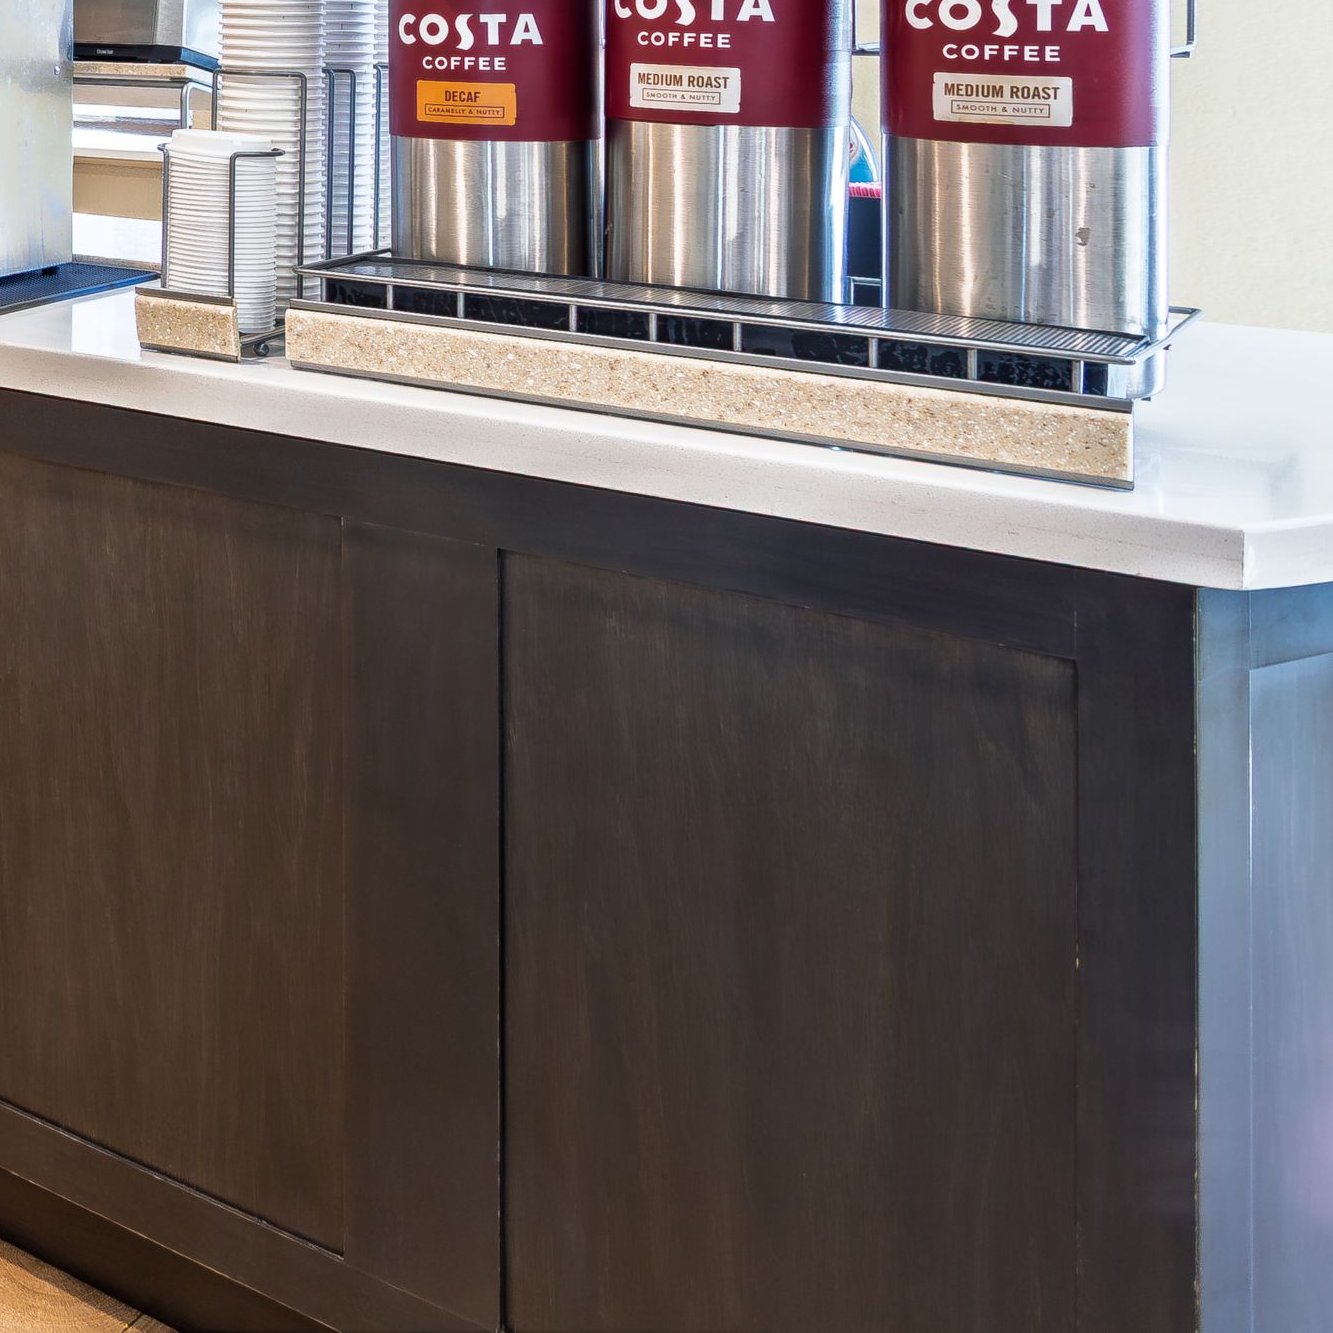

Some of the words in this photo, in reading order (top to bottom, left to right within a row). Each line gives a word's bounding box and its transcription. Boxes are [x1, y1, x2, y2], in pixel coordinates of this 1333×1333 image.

[398, 13, 543, 51] COSTA
[637, 31, 731, 48] COFFEE
[942, 44, 1061, 61] COFFEE
[422, 56, 506, 71] COFFEE
[637, 72, 683, 87] MEDIUM
[687, 75, 730, 89] ROAST
[444, 90, 481, 103] DECAF
[646, 91, 677, 100] SMOOTH
[689, 94, 716, 102] NUTTY
[944, 82, 1004, 98] MEDIUM
[1010, 85, 1061, 100] ROAST
[427, 106, 466, 115] CARAMELLY
[476, 108, 501, 116] NUTTY
[956, 103, 997, 113] SMOOTH
[1012, 106, 1045, 114] NUTTY
